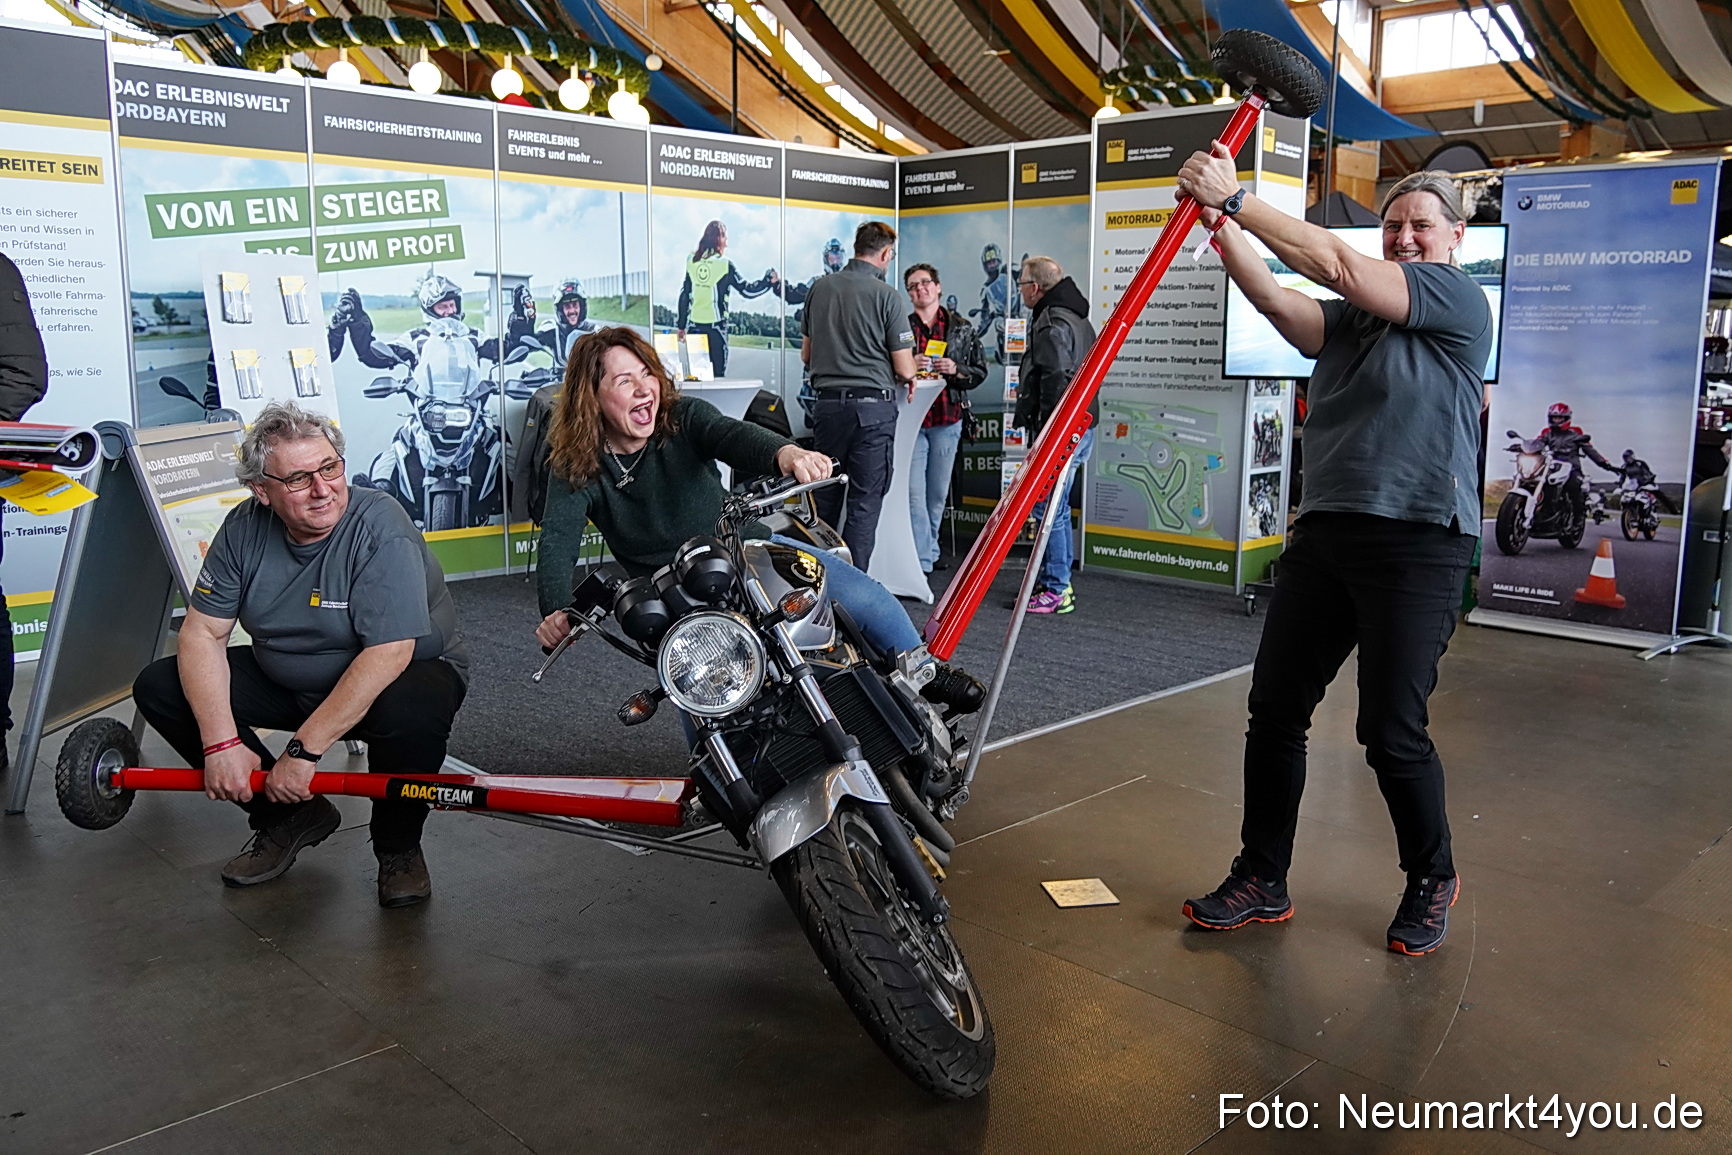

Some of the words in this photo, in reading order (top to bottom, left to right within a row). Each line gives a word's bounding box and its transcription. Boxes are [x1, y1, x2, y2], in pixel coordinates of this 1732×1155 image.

[115, 78, 149, 97] DAC
[156, 83, 290, 113] ERLEBNISWELT
[116, 102, 226, 127] ORDBAYERN
[324, 115, 482, 144] FAHRSICHERHEITSTRAINING
[508, 129, 580, 148] FAHRERLEBNIS
[508, 144, 545, 159] EVENTS
[548, 148, 566, 161] und
[567, 150, 591, 164] mehr
[660, 144, 691, 159] ADAC
[694, 148, 773, 169] ERLEBNISWELT
[62, 162, 99, 176] SEIN
[660, 161, 735, 181] NORDBAYERN
[792, 169, 889, 190] FAHRSICHERHEITSTRAINING
[905, 170, 957, 184] FAHRERLEBNIS
[1673, 178, 1698, 190] ADAC
[905, 184, 931, 195] EVENTS
[933, 182, 946, 193] und
[947, 181, 965, 192] mehr
[1537, 194, 1561, 202] BMW
[16, 206, 32, 217] ein
[36, 207, 78, 219] sicherer
[156, 201, 235, 230] VOM
[246, 196, 300, 224] EIN
[322, 188, 441, 219] STEIGER
[1536, 201, 1590, 211] MOTORRAD
[1108, 212, 1173, 226] MOTORRAD-T
[20, 224, 40, 233] und
[43, 225, 82, 236] Wissen
[85, 227, 95, 236] in
[12, 239, 66, 251] Prüfstand!
[323, 239, 378, 264] ZUM
[387, 233, 455, 258] PROFI
[48, 257, 65, 267] Sie
[68, 258, 106, 268] heraus-
[1513, 253, 1539, 266] DIE
[1543, 252, 1585, 266] BMW
[1589, 250, 1692, 266] MOTORRAD
[1114, 265, 1133, 273] ADAC
[66, 290, 106, 300] Fahrma-
[40, 306, 98, 316] fahrerische
[47, 323, 94, 332] erfahren.
[1200, 320, 1223, 328] Intensi
[1199, 338, 1219, 346] Basis
[1198, 356, 1222, 365] Kompa
[66, 368, 83, 376] wie
[86, 367, 102, 377] Sie
[1174, 372, 1207, 382] Umgebung
[976, 419, 1000, 439] HR
[145, 459, 167, 472] ADAC
[168, 450, 215, 468] ERLEBNISWELT
[3, 525, 68, 537] n-Trainings
[1092, 545, 1230, 573] www.fahrerlebnis-bayern.de
[1493, 583, 1513, 592] MAKE
[1514, 586, 1530, 594] LIFE
[1536, 589, 1554, 597] RIDE
